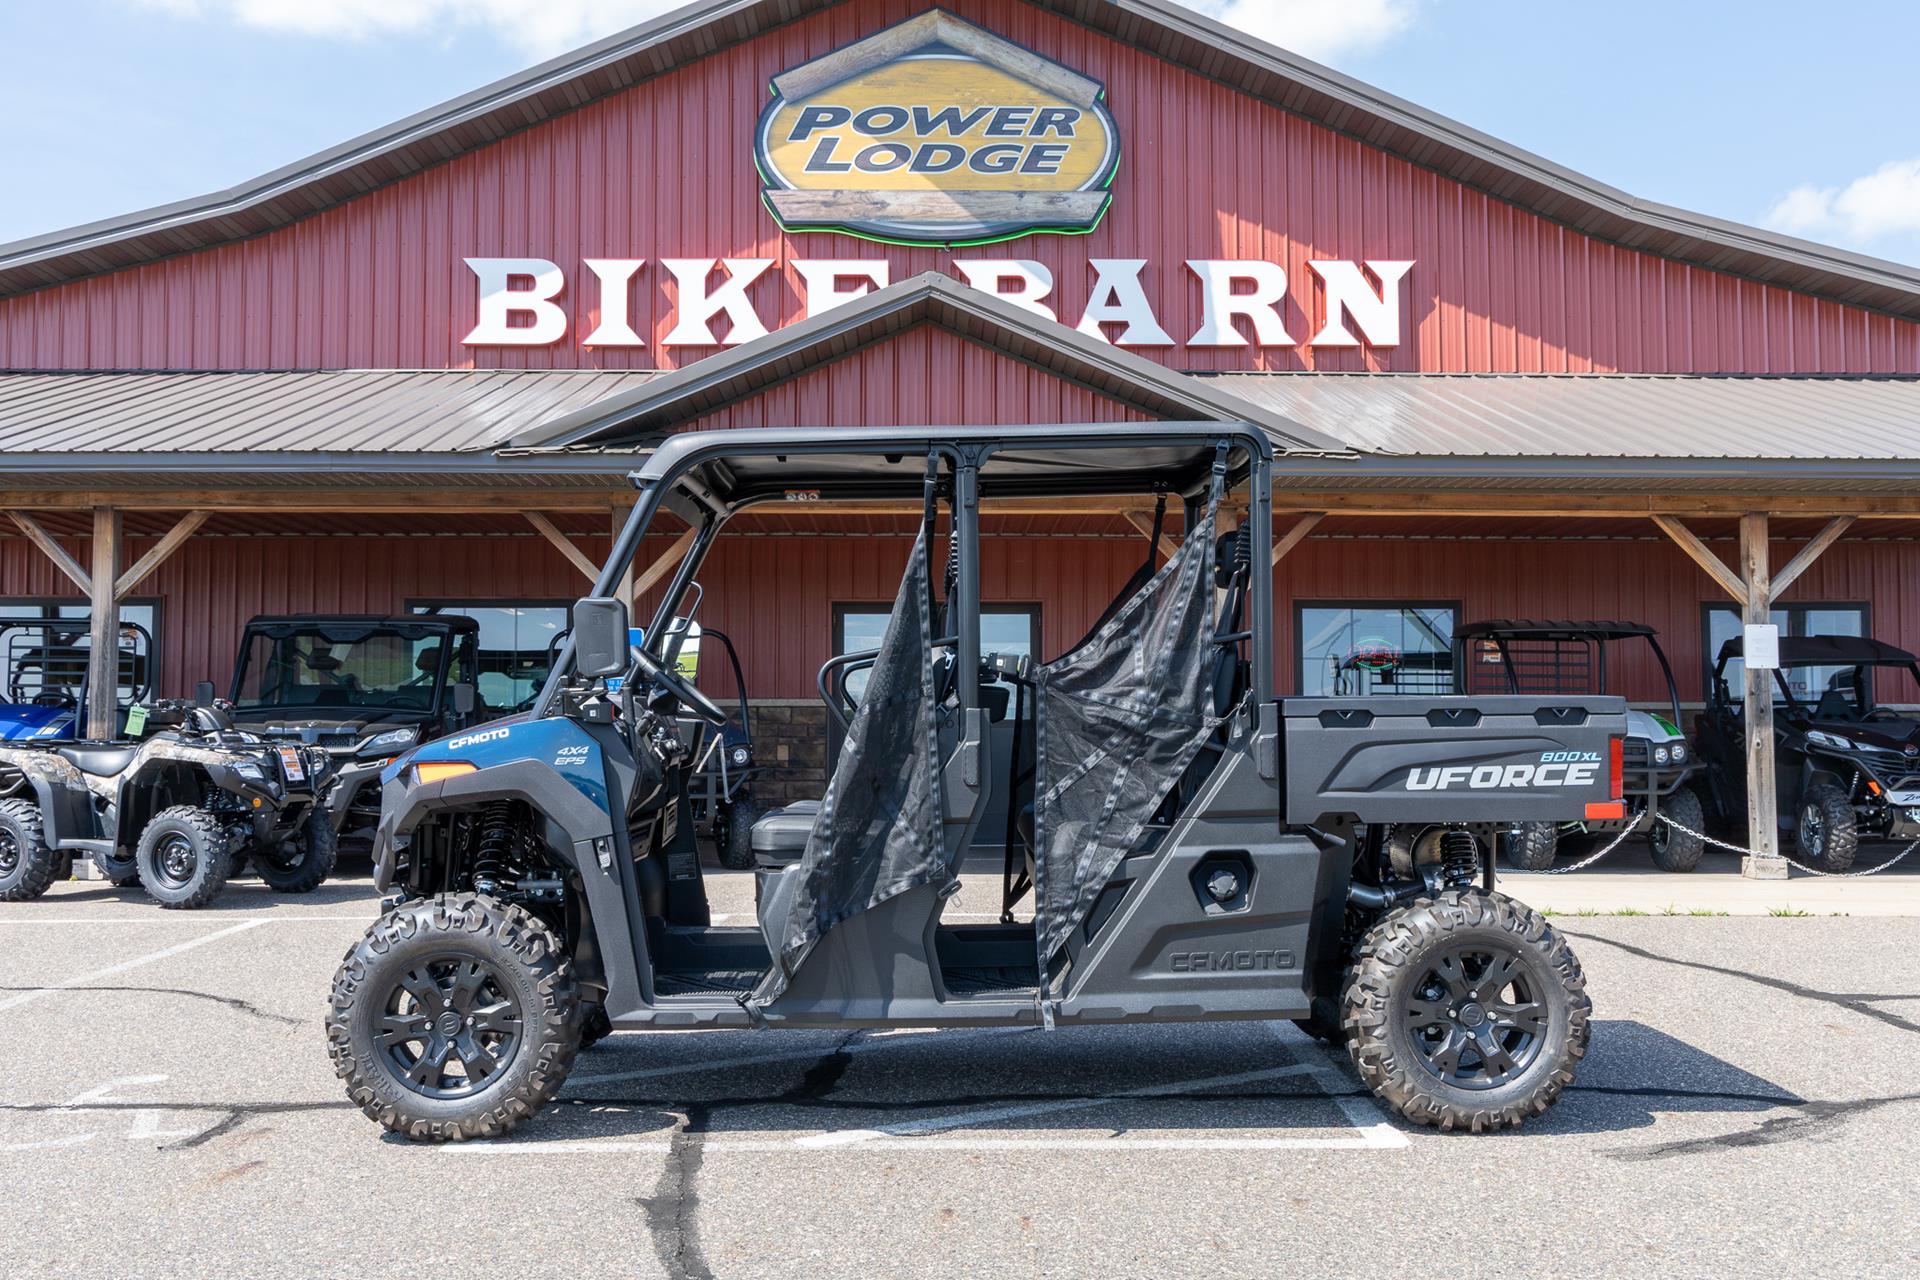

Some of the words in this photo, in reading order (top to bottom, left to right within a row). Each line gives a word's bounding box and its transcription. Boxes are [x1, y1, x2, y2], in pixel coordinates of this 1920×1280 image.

[786, 105, 1081, 142] POWER
[803, 136, 1070, 175] LODGE
[952, 258, 1417, 347] BARN
[448, 728, 510, 749] CFMOTO
[554, 756, 587, 766] EPS
[1405, 762, 1600, 791] UFORCE
[1169, 949, 1296, 973] CFMOTO
